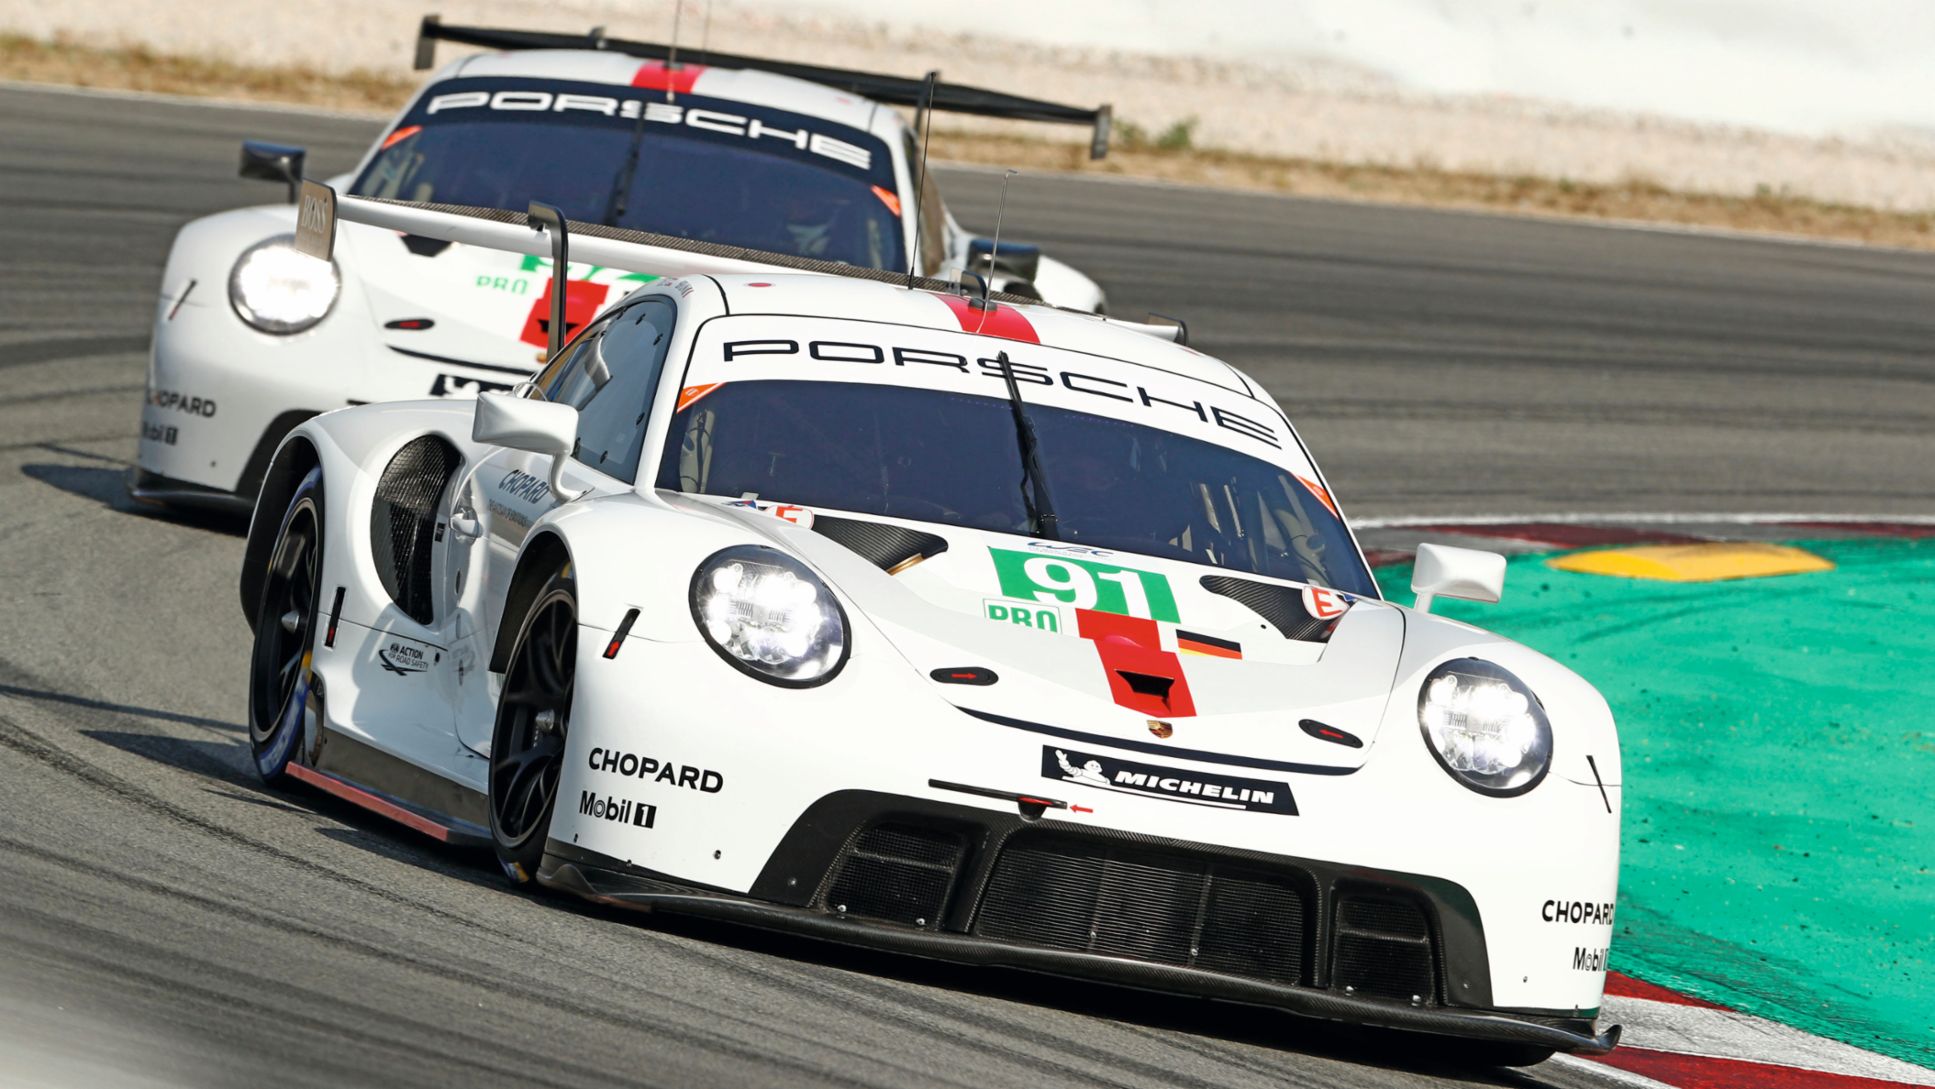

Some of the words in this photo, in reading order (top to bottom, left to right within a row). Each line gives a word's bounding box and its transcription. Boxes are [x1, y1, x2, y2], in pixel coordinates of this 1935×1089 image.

[426, 90, 871, 171] PORSCHE
[722, 339, 1283, 450] PORSCHE
[498, 469, 550, 505] CHOPARD
[1023, 557, 1153, 621] 91
[988, 604, 1058, 633] PRO
[396, 654, 411, 666] ROAD
[411, 659, 429, 670] SAFETY
[400, 646, 424, 660] ACTION
[588, 747, 724, 794] CHOPARD
[1114, 770, 1275, 805] MICHELIN
[579, 790, 632, 824] Mobil
